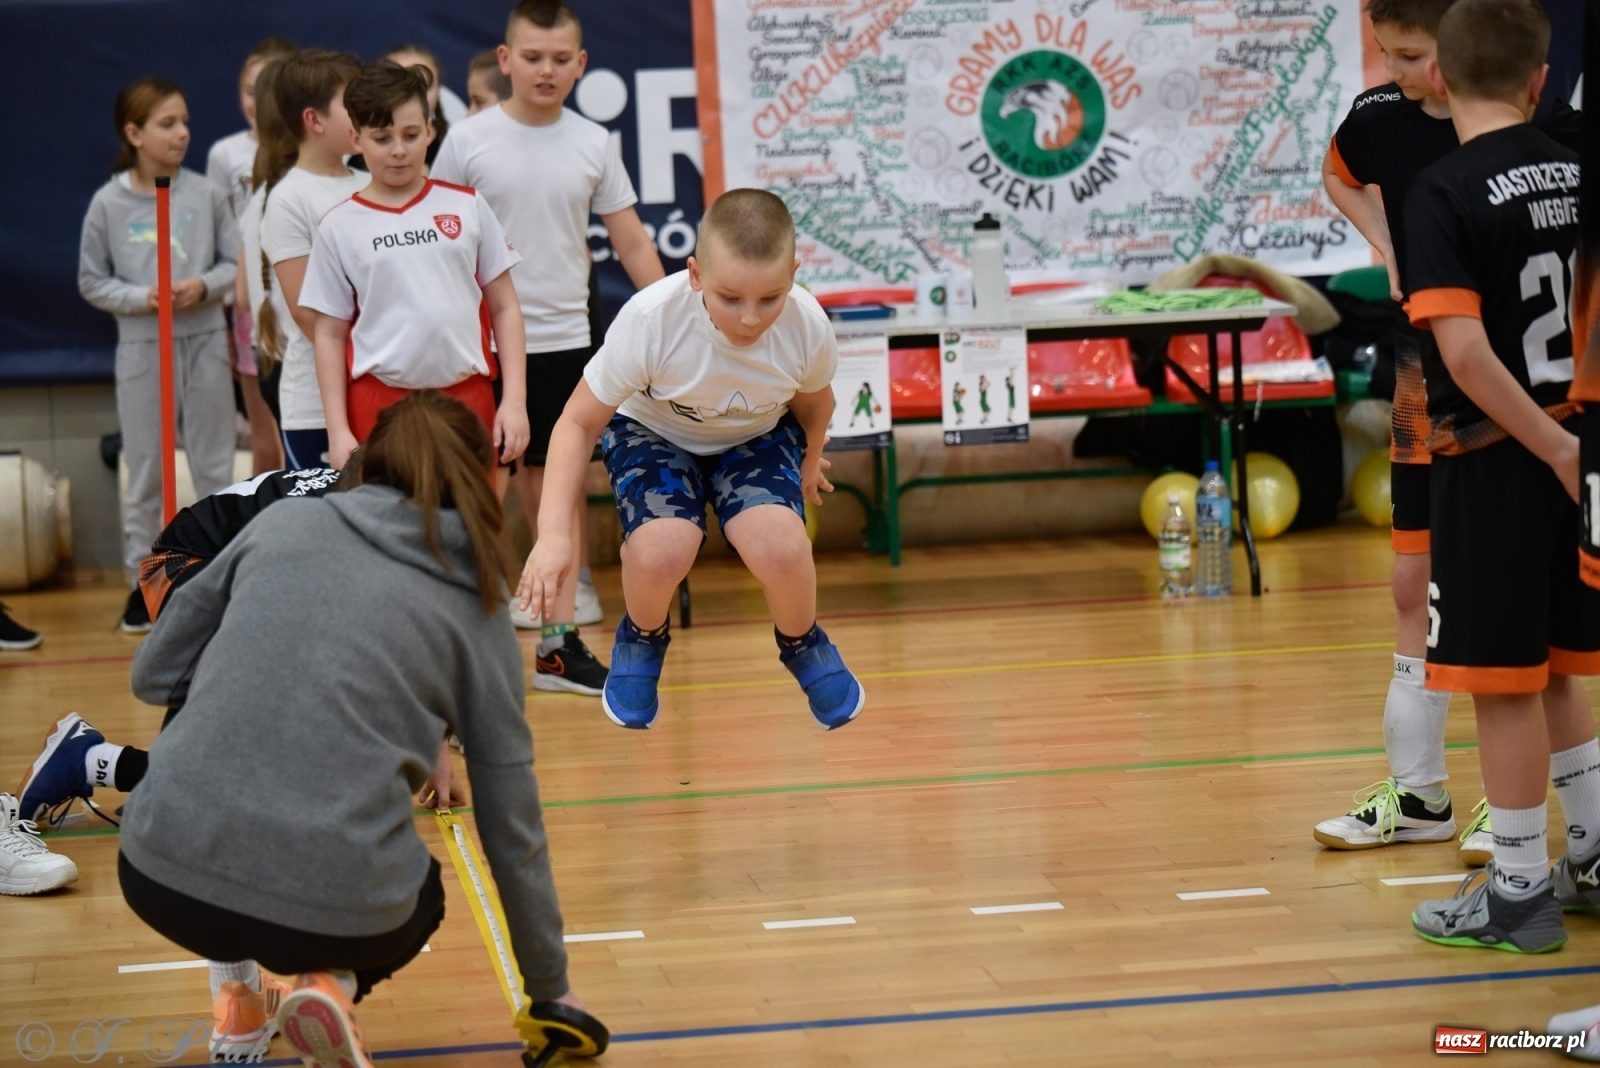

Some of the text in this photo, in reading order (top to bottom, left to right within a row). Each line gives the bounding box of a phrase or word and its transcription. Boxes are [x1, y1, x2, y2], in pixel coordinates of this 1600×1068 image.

[944, 12, 1143, 117] GRAMY DLA WAS
[1070, 130, 1139, 205] WAM!
[1486, 160, 1581, 206] JASTRZĘBS
[1527, 196, 1580, 231] WĘGIE
[372, 229, 439, 251] POLSKA
[1239, 218, 1348, 261] CezaryS
[1519, 250, 1577, 388] 2
